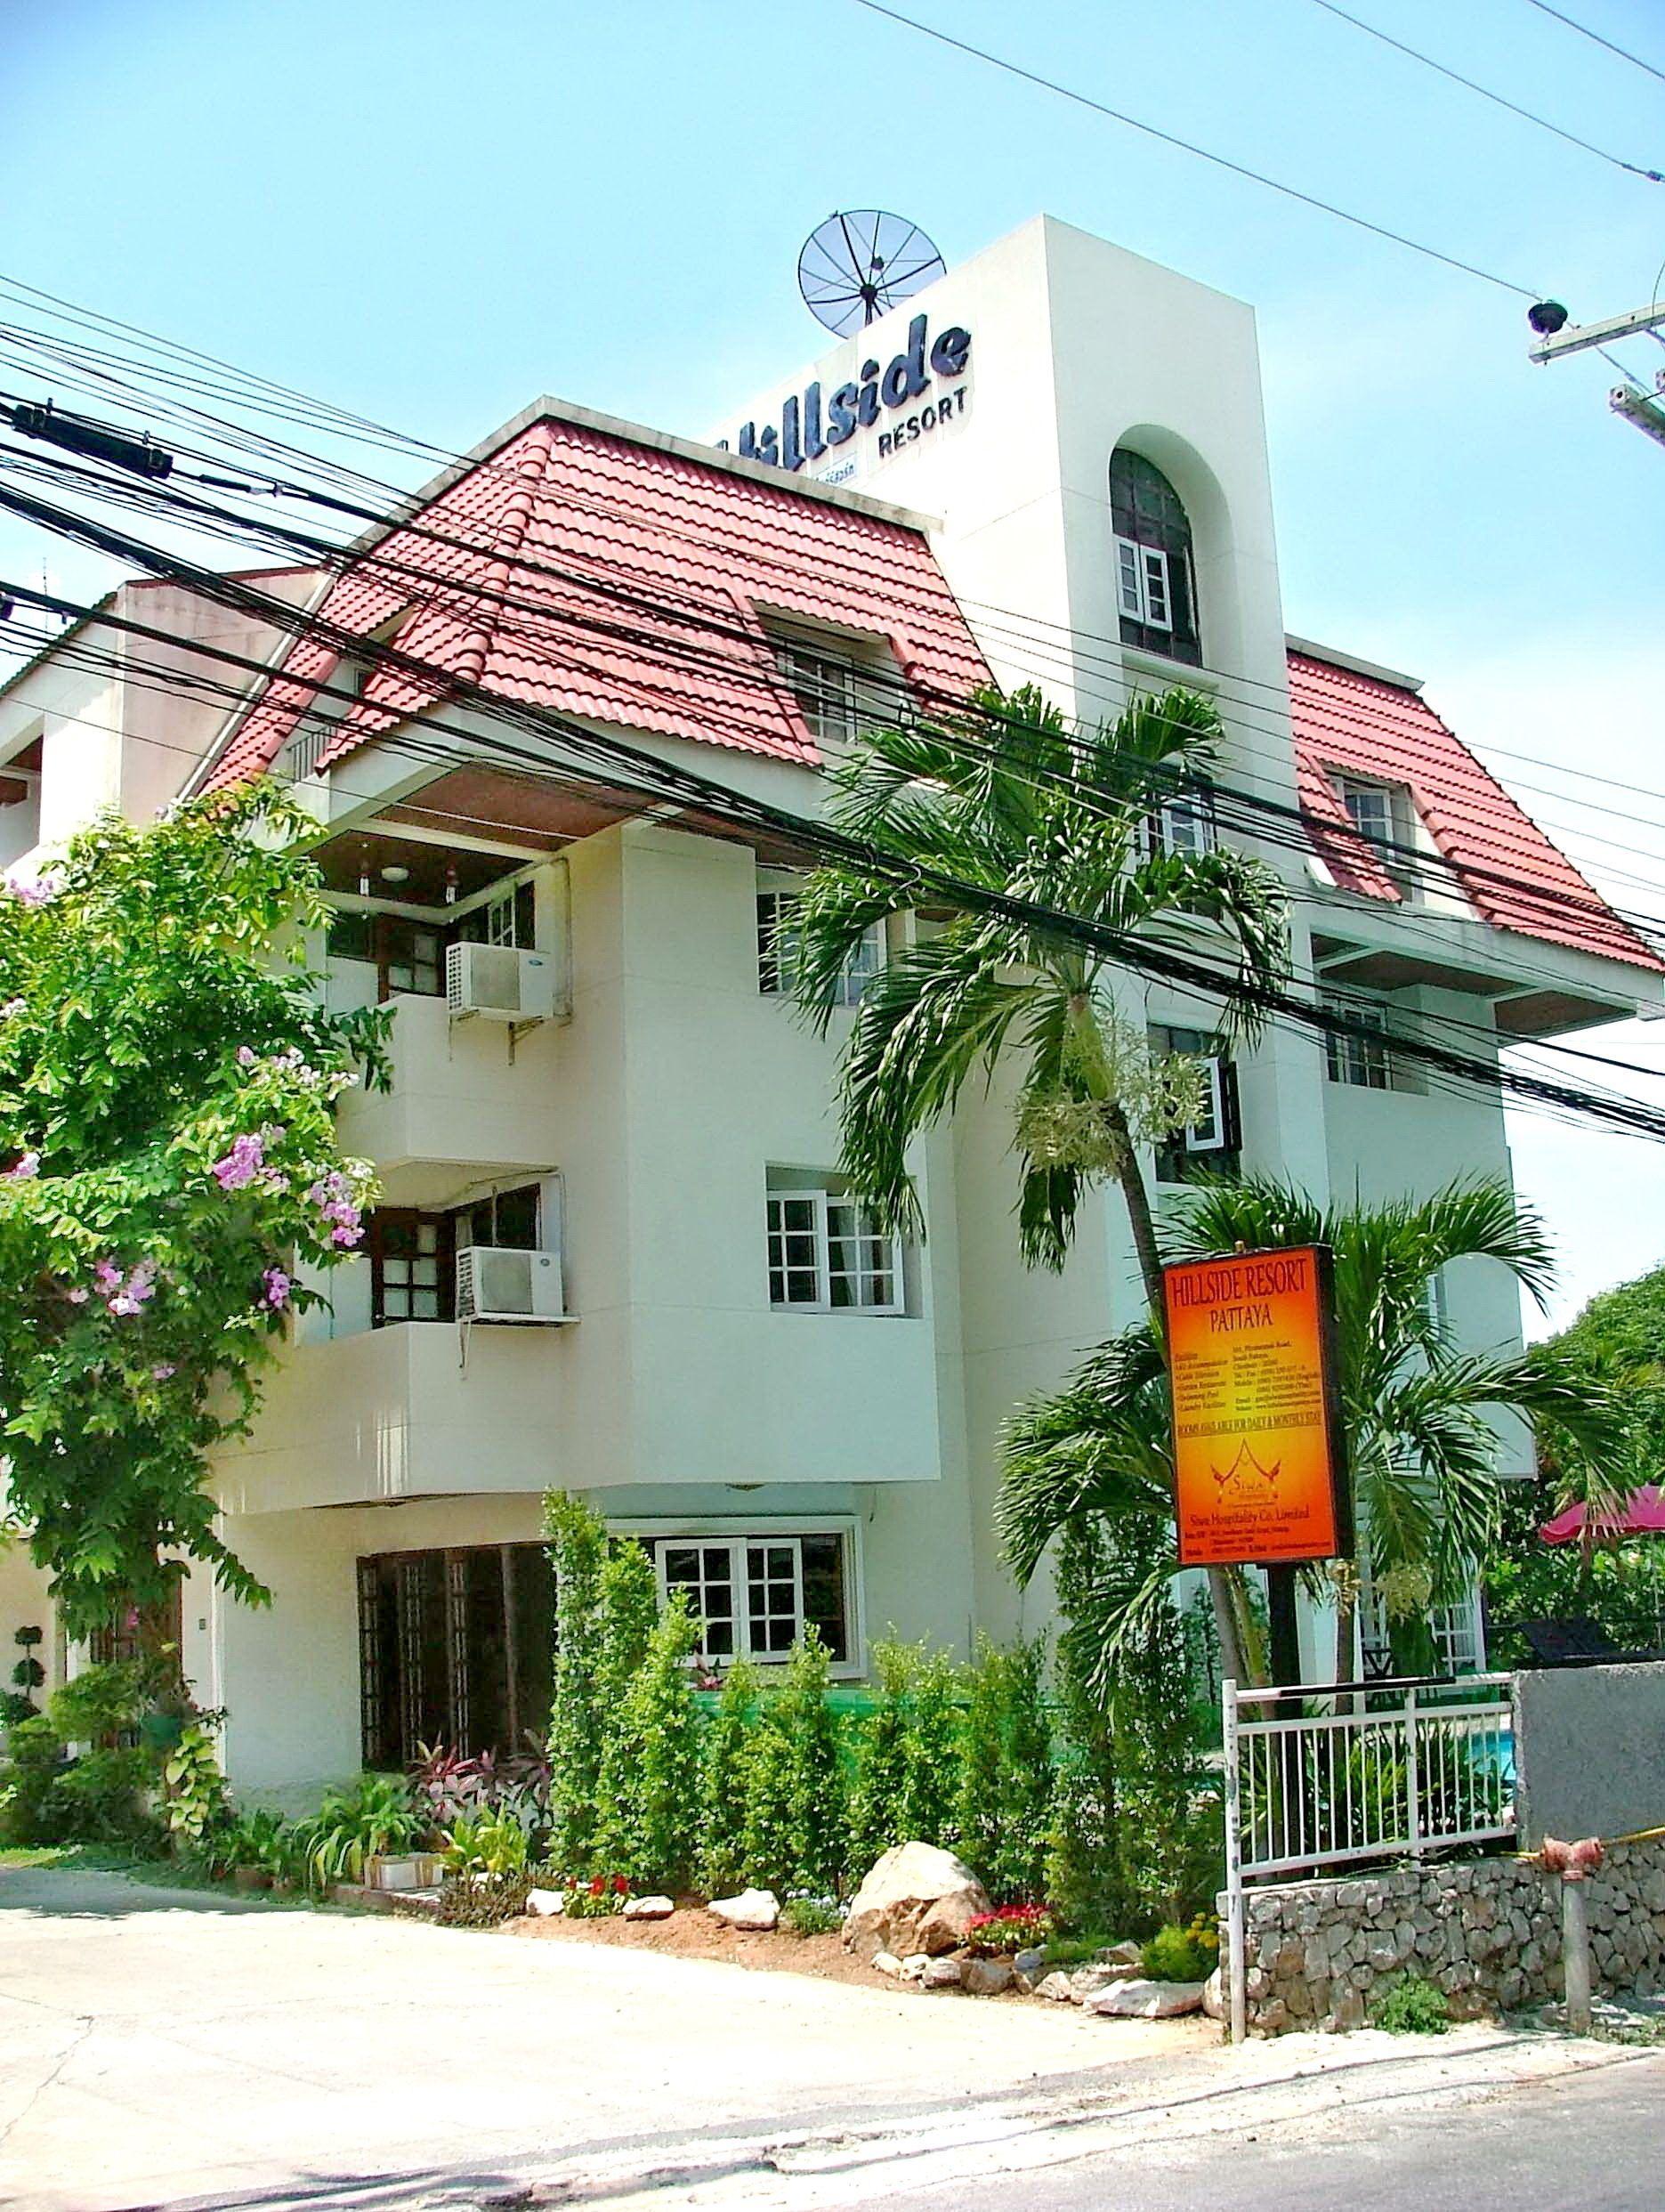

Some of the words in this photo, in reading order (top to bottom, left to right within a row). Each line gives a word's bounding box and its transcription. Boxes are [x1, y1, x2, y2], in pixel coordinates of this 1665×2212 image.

[878, 386, 967, 459] RESORT
[1171, 1268, 1241, 1308] HILLSIDE
[1247, 1259, 1306, 1296] RESORT
[1210, 1304, 1273, 1333] PATTAYA
